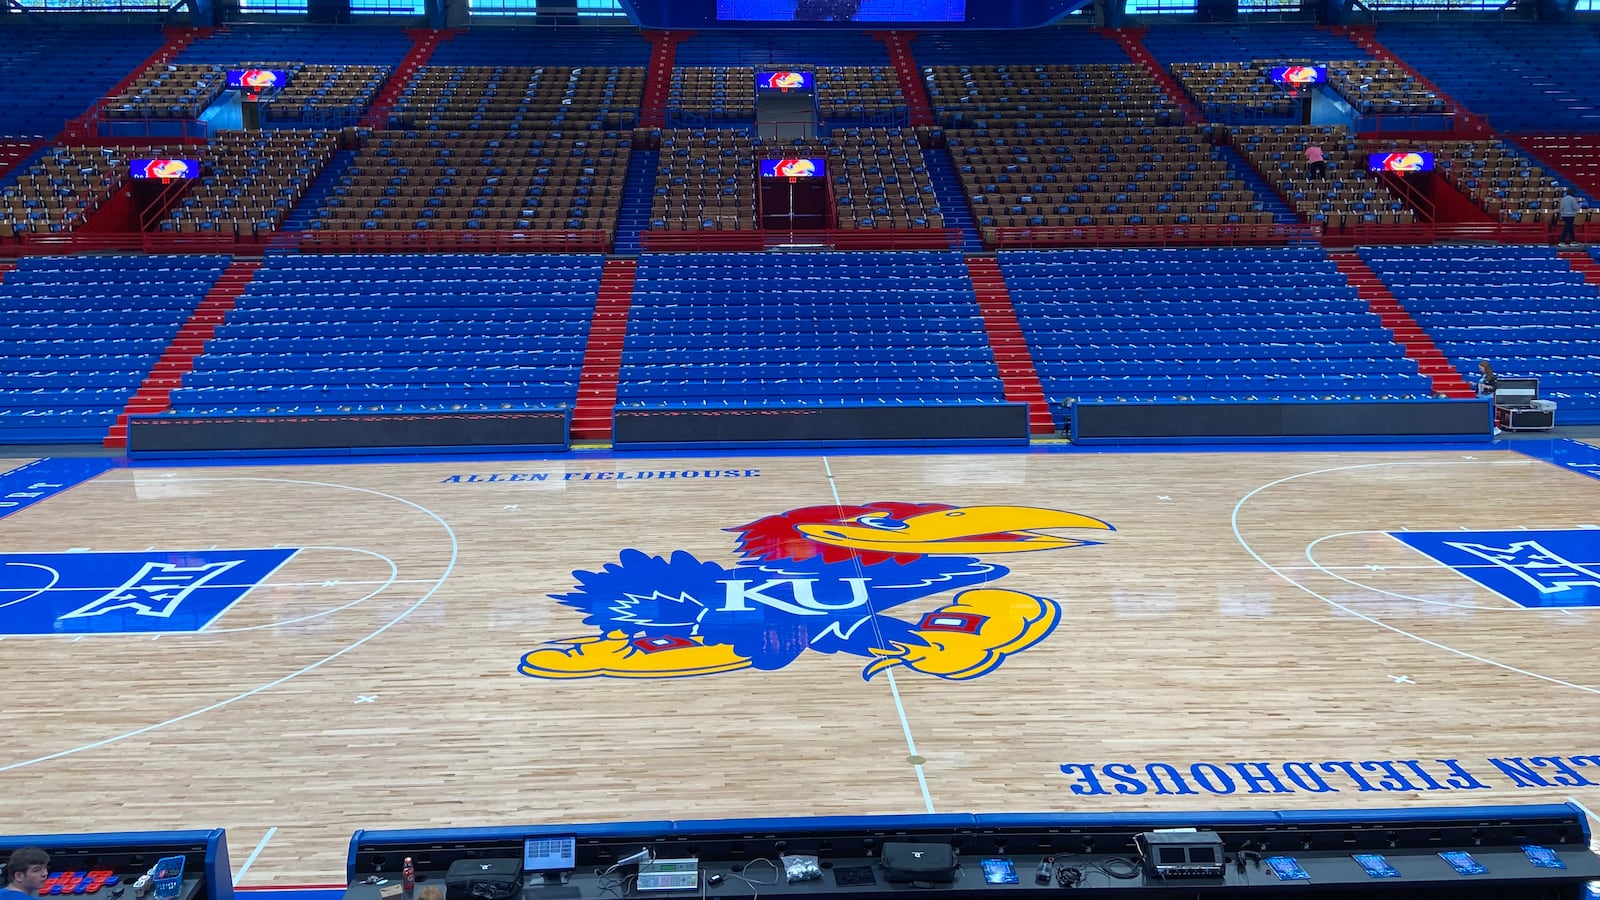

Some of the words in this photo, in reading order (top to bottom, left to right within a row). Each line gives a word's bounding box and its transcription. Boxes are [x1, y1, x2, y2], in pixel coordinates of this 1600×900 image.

[442, 473, 549, 484] ALLEN
[563, 469, 761, 482] FIELDHOUSE
[715, 577, 873, 616] KU
[1059, 758, 1492, 797] FIELDHOUSE
